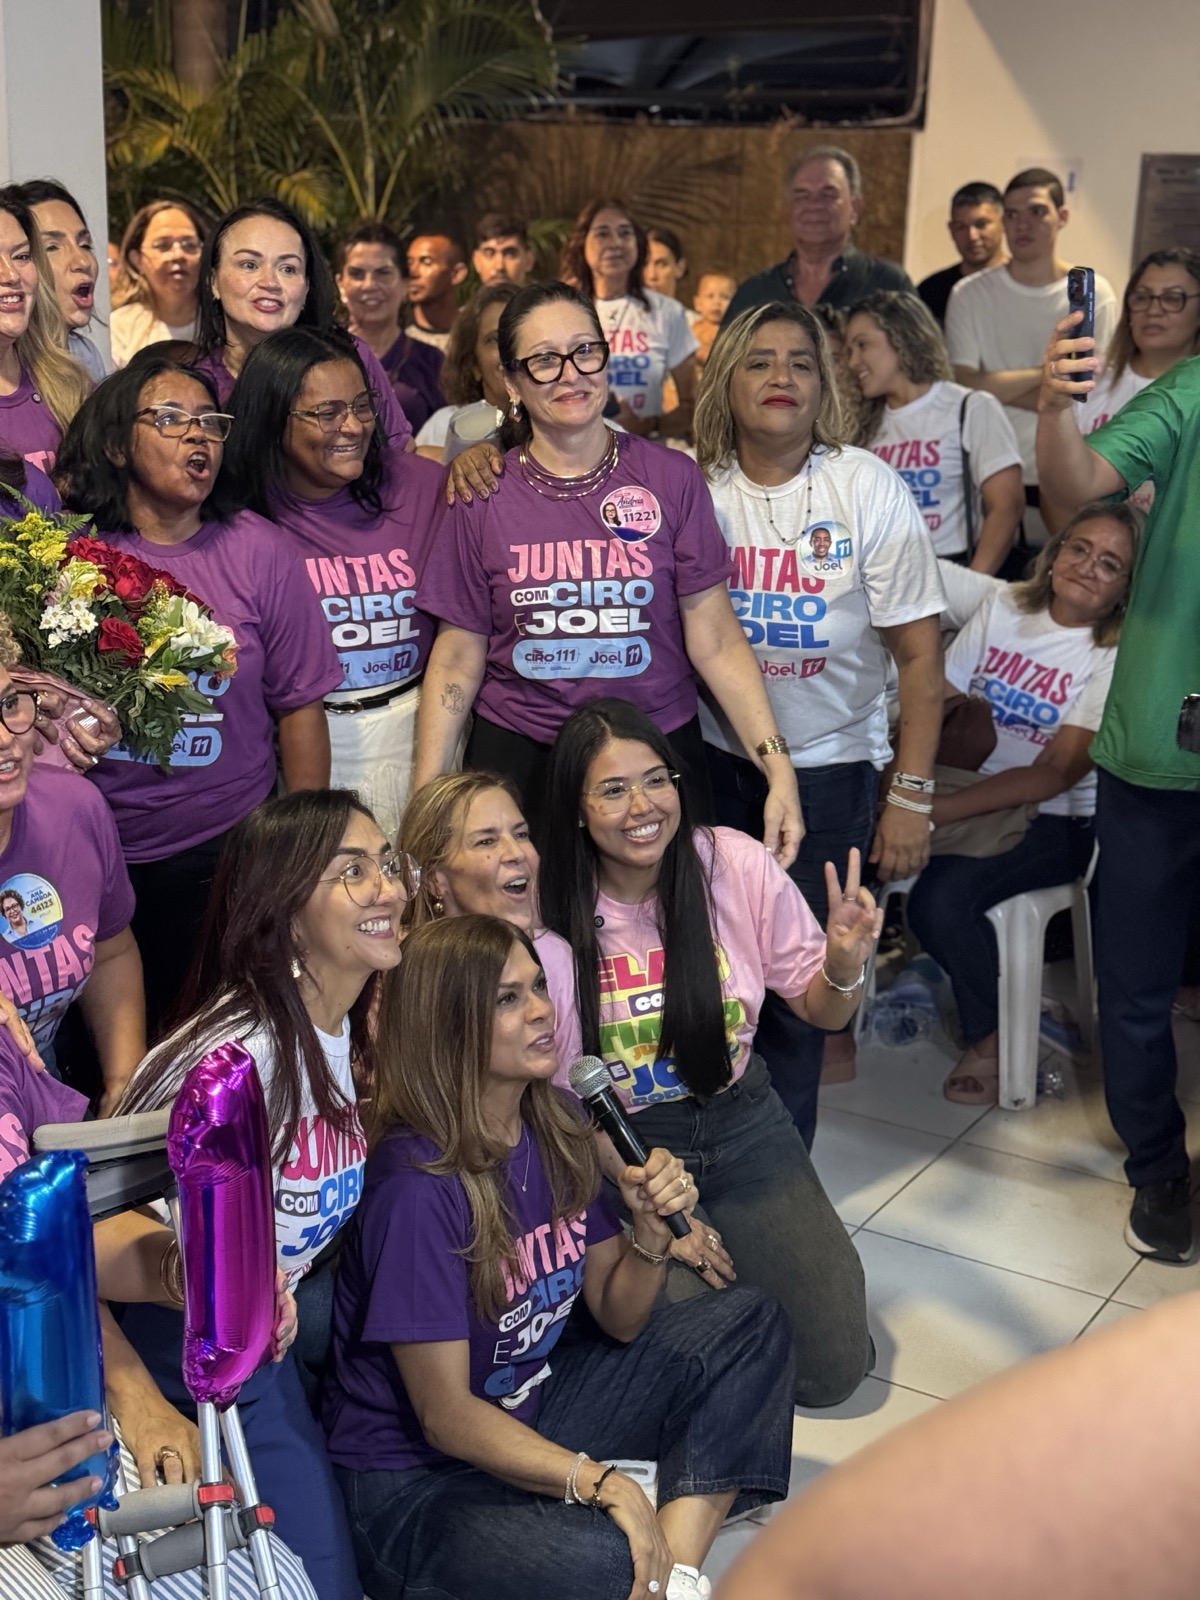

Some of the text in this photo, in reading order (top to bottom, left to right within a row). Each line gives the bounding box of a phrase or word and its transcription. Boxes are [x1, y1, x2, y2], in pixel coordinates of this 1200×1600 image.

[897, 469, 942, 488] RO
[624, 510, 657, 522] 11221
[838, 541, 850, 557] 11
[507, 538, 653, 583] JUNTAS
[814, 559, 843, 571] Joel
[514, 580, 654, 607] COM CIRO
[514, 608, 651, 635] E JOEL
[331, 618, 420, 647] OEL
[739, 619, 830, 649] OEL
[525, 647, 640, 664] CIRO 111 Joel 11
[362, 658, 392, 674] Joel
[760, 660, 797, 676] Joel
[985, 679, 1059, 725] CIRO
[193, 738, 210, 754] 11
[31, 890, 43, 898] ANA
[31, 898, 53, 914] 44123
[635, 992, 664, 1011] CO
[610, 1058, 683, 1096] E JO
[280, 1164, 364, 1217] COM CIR
[493, 1339, 511, 1364] E
